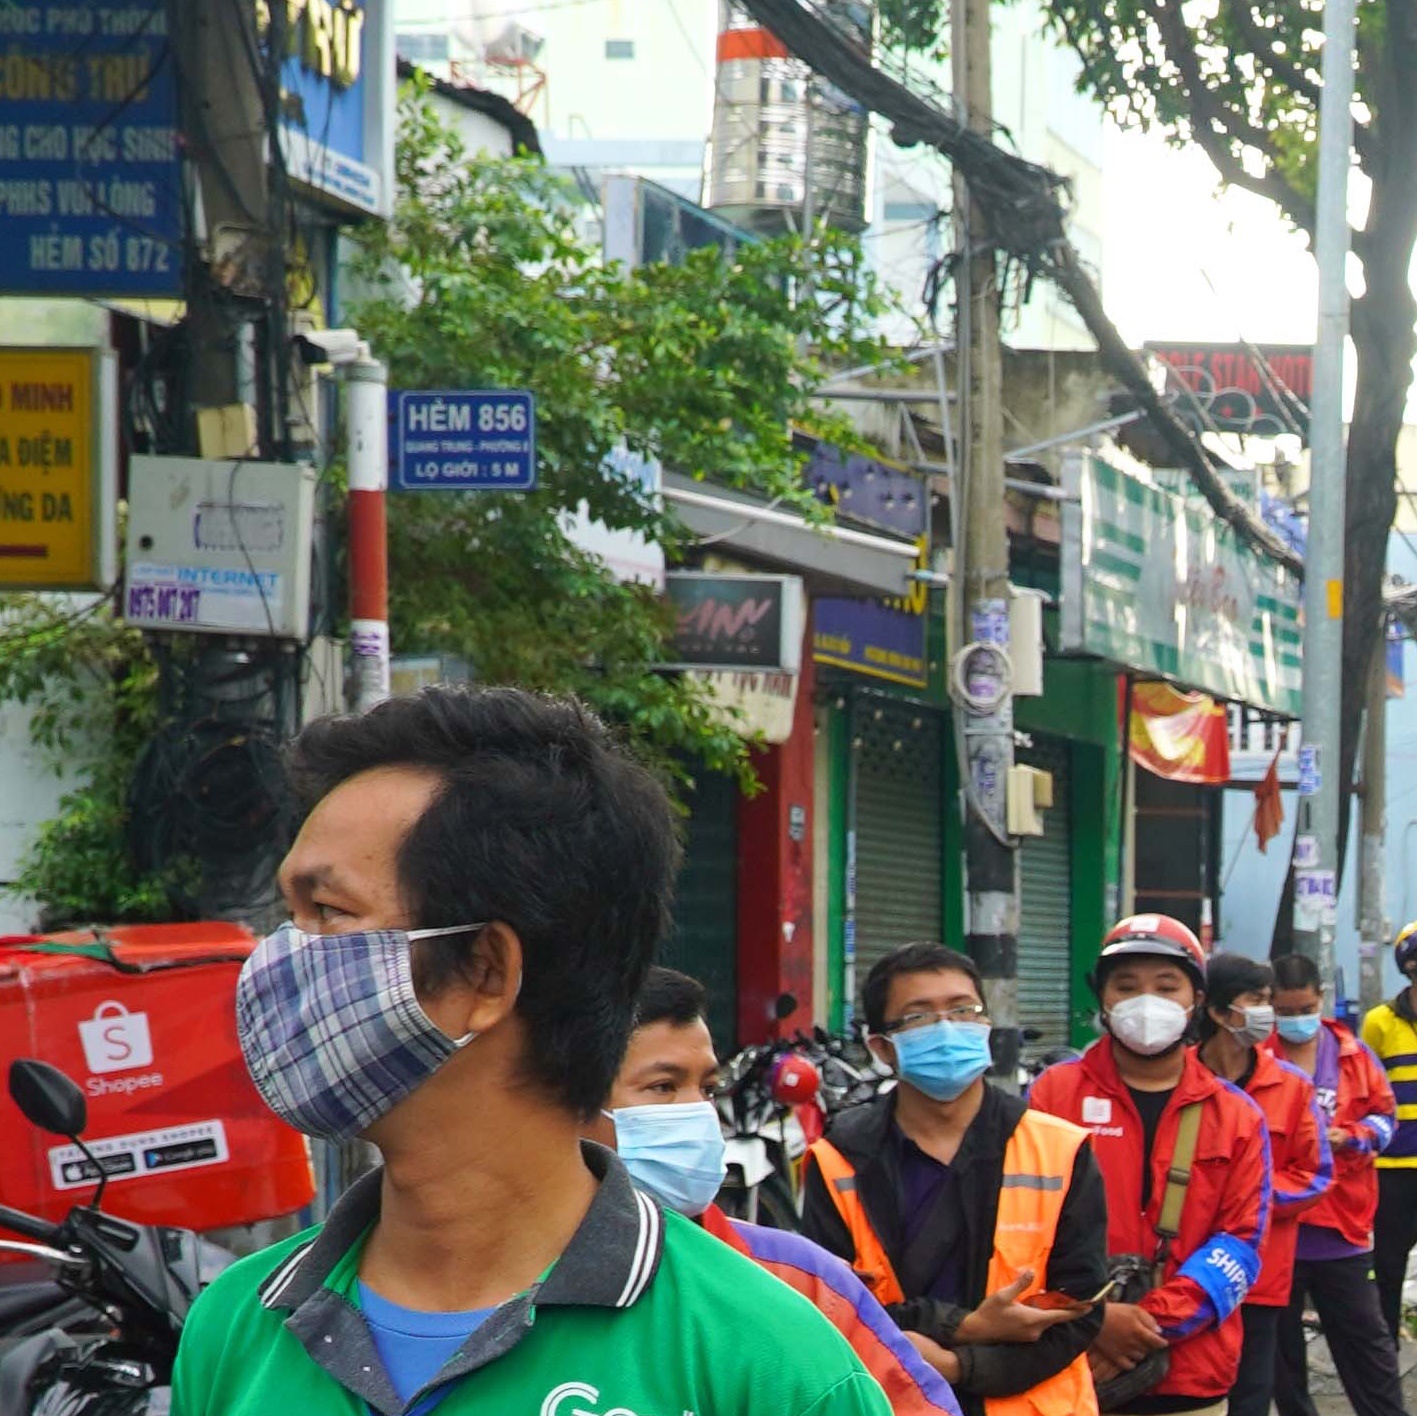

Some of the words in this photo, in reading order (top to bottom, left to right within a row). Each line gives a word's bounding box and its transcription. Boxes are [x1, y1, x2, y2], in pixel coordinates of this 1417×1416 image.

[88, 224, 119, 272] SỐ
[127, 238, 169, 272] 872
[409, 397, 471, 432] HẺM
[479, 404, 526, 432] 856
[504, 462, 519, 477] M
[86, 1073, 163, 1097] Shopee
